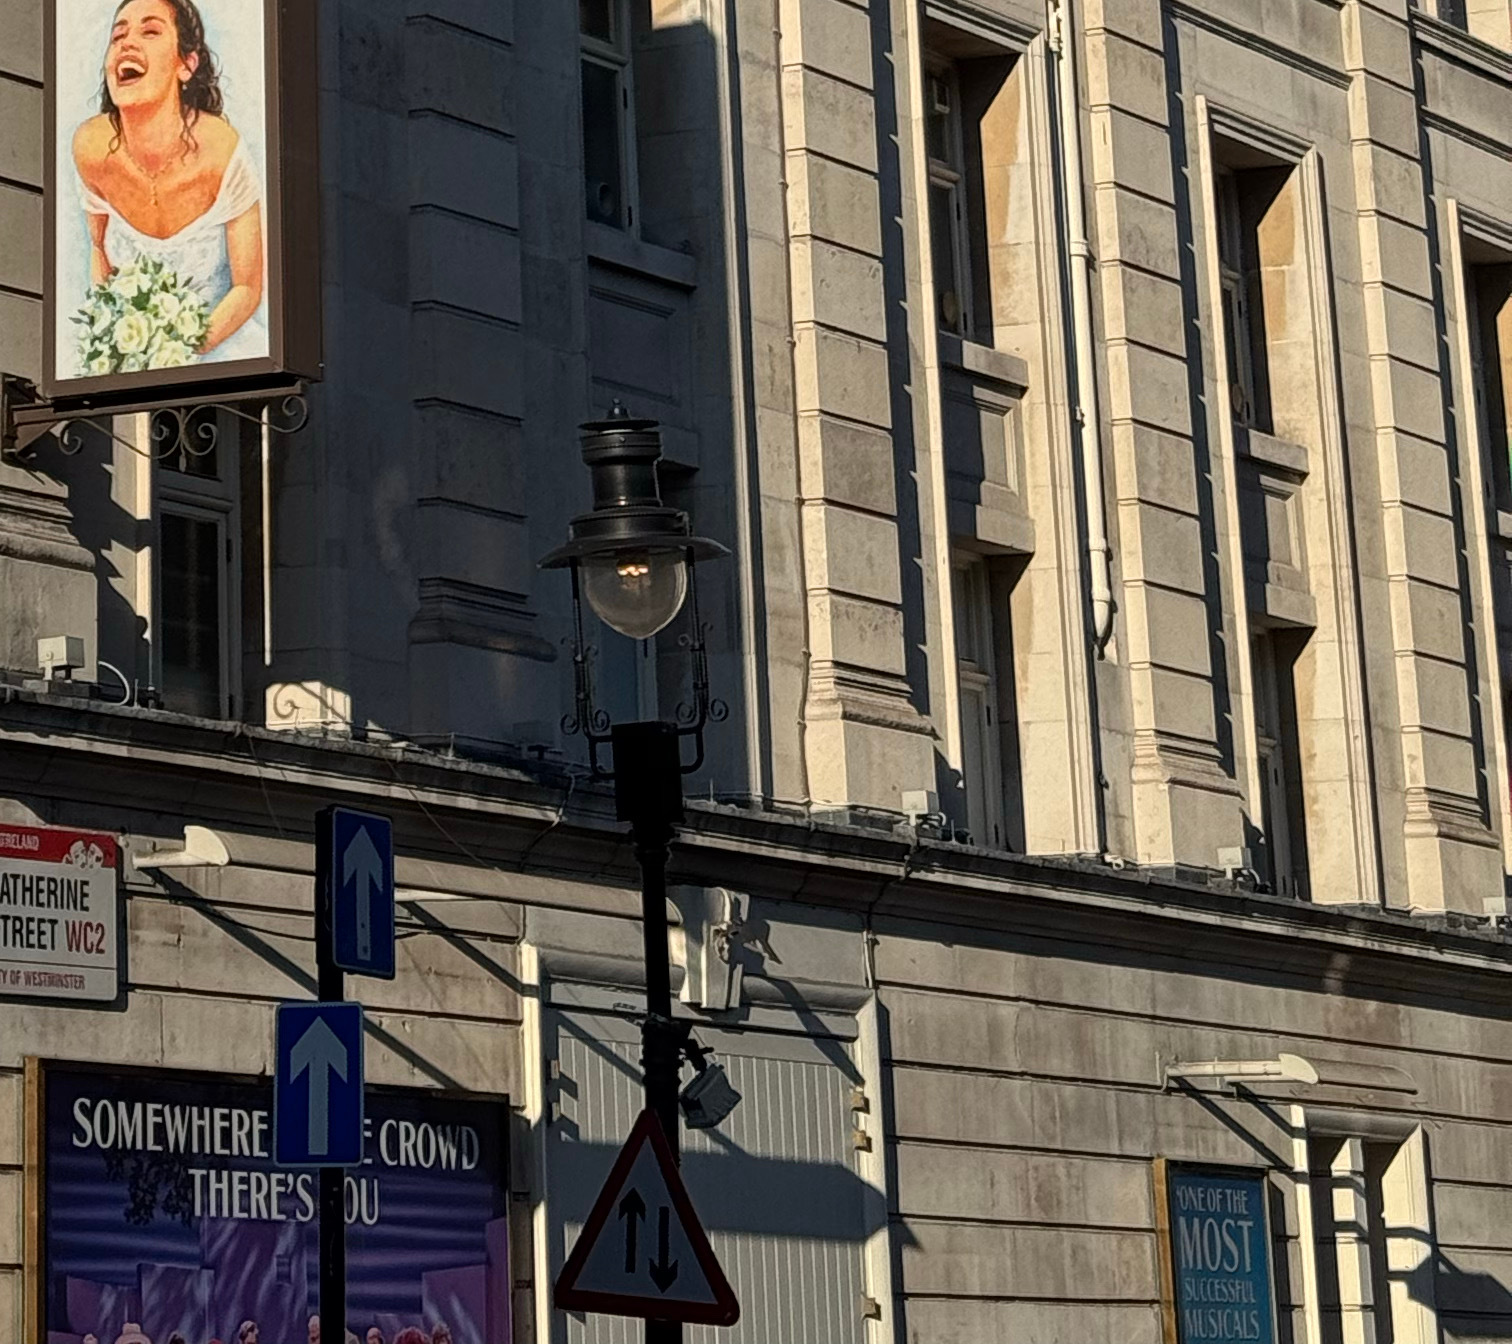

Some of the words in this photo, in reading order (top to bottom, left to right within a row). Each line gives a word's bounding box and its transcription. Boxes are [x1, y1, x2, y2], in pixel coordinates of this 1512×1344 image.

[65, 920, 105, 955] WC2
[10, 969, 21, 985] OF
[23, 970, 86, 990] WESTMINSTER
[73, 1097, 269, 1158] SOMEWHERE
[380, 1119, 480, 1170] CROWD
[343, 1176, 379, 1226] OU
[1207, 1188, 1223, 1213] OF
[1225, 1189, 1248, 1215] THE
[1179, 1216, 1254, 1273] MOST
[1184, 1278, 1256, 1304] SUCCESSFUL
[1185, 1308, 1260, 1340] MUSICALS
